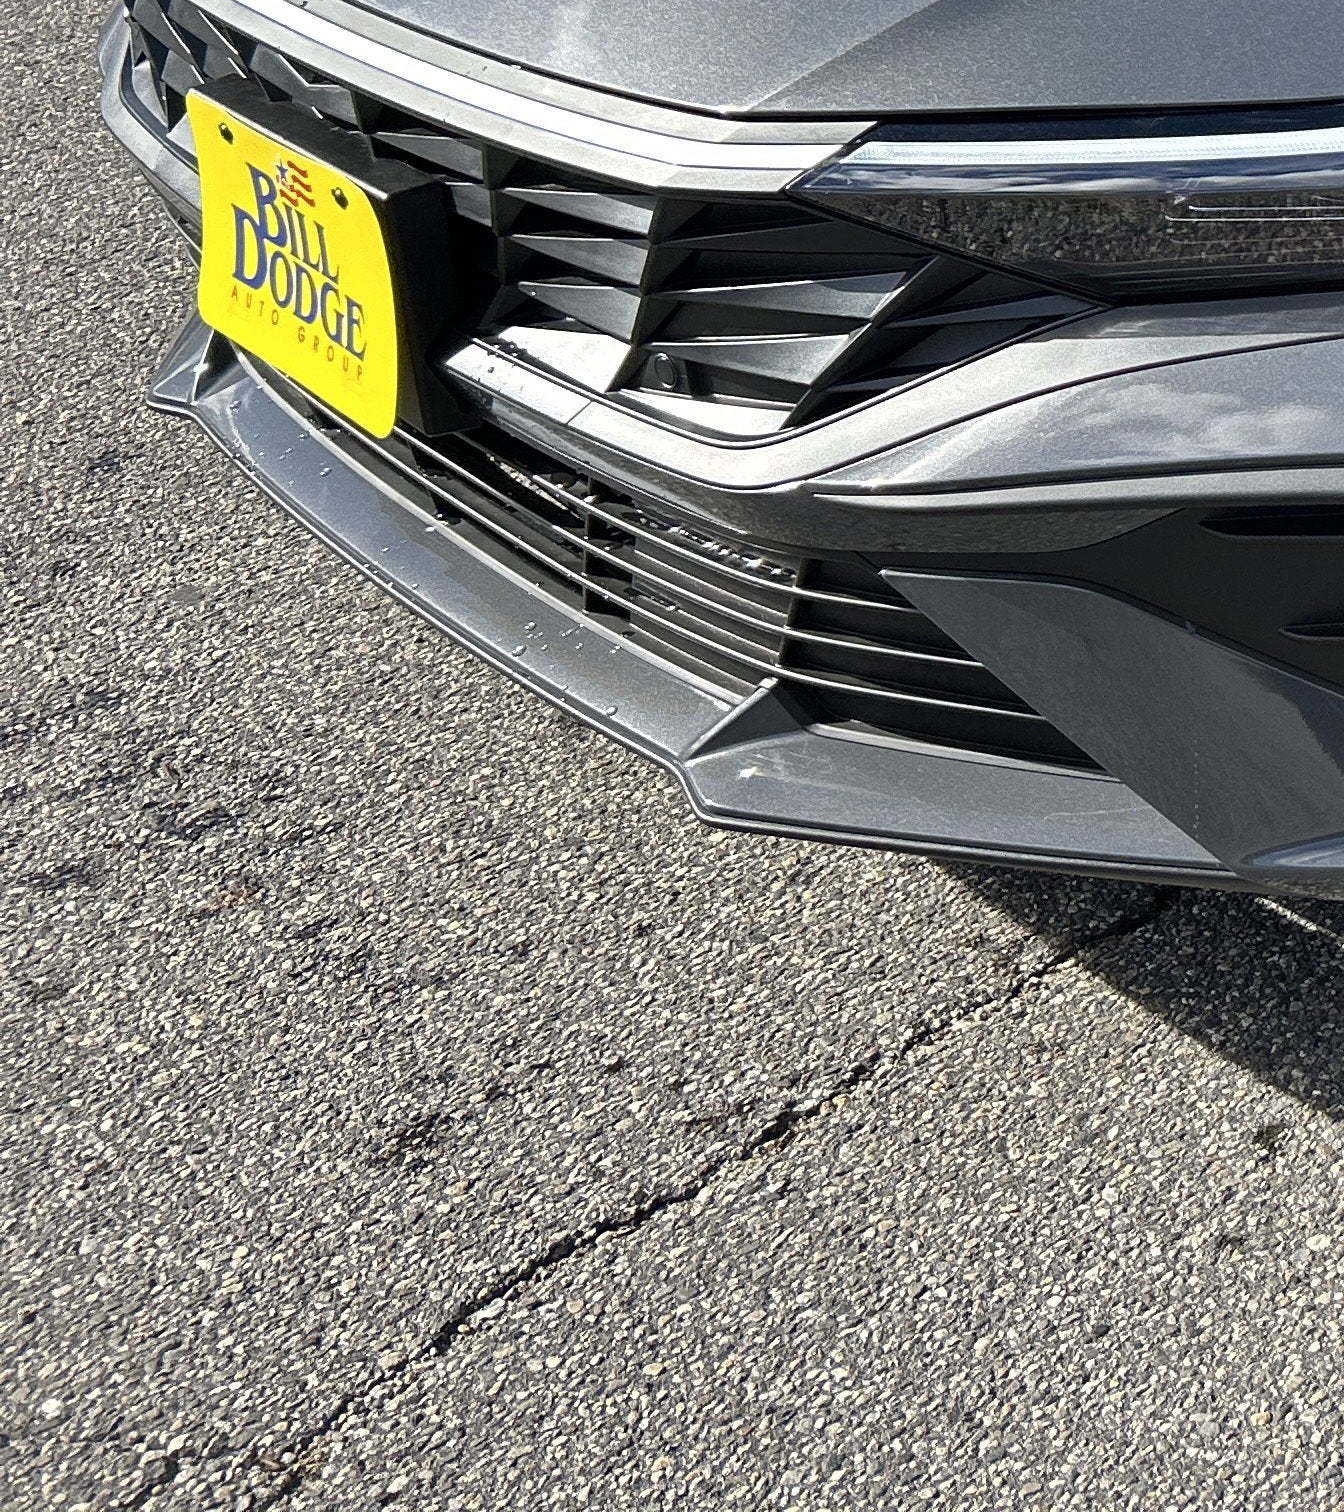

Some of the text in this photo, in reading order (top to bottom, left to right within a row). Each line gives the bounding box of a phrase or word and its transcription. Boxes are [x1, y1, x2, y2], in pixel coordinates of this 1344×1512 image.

[231, 203, 367, 361] DODGE
[245, 161, 340, 284] BILL
[231, 285, 364, 382] AUTO GROUP
